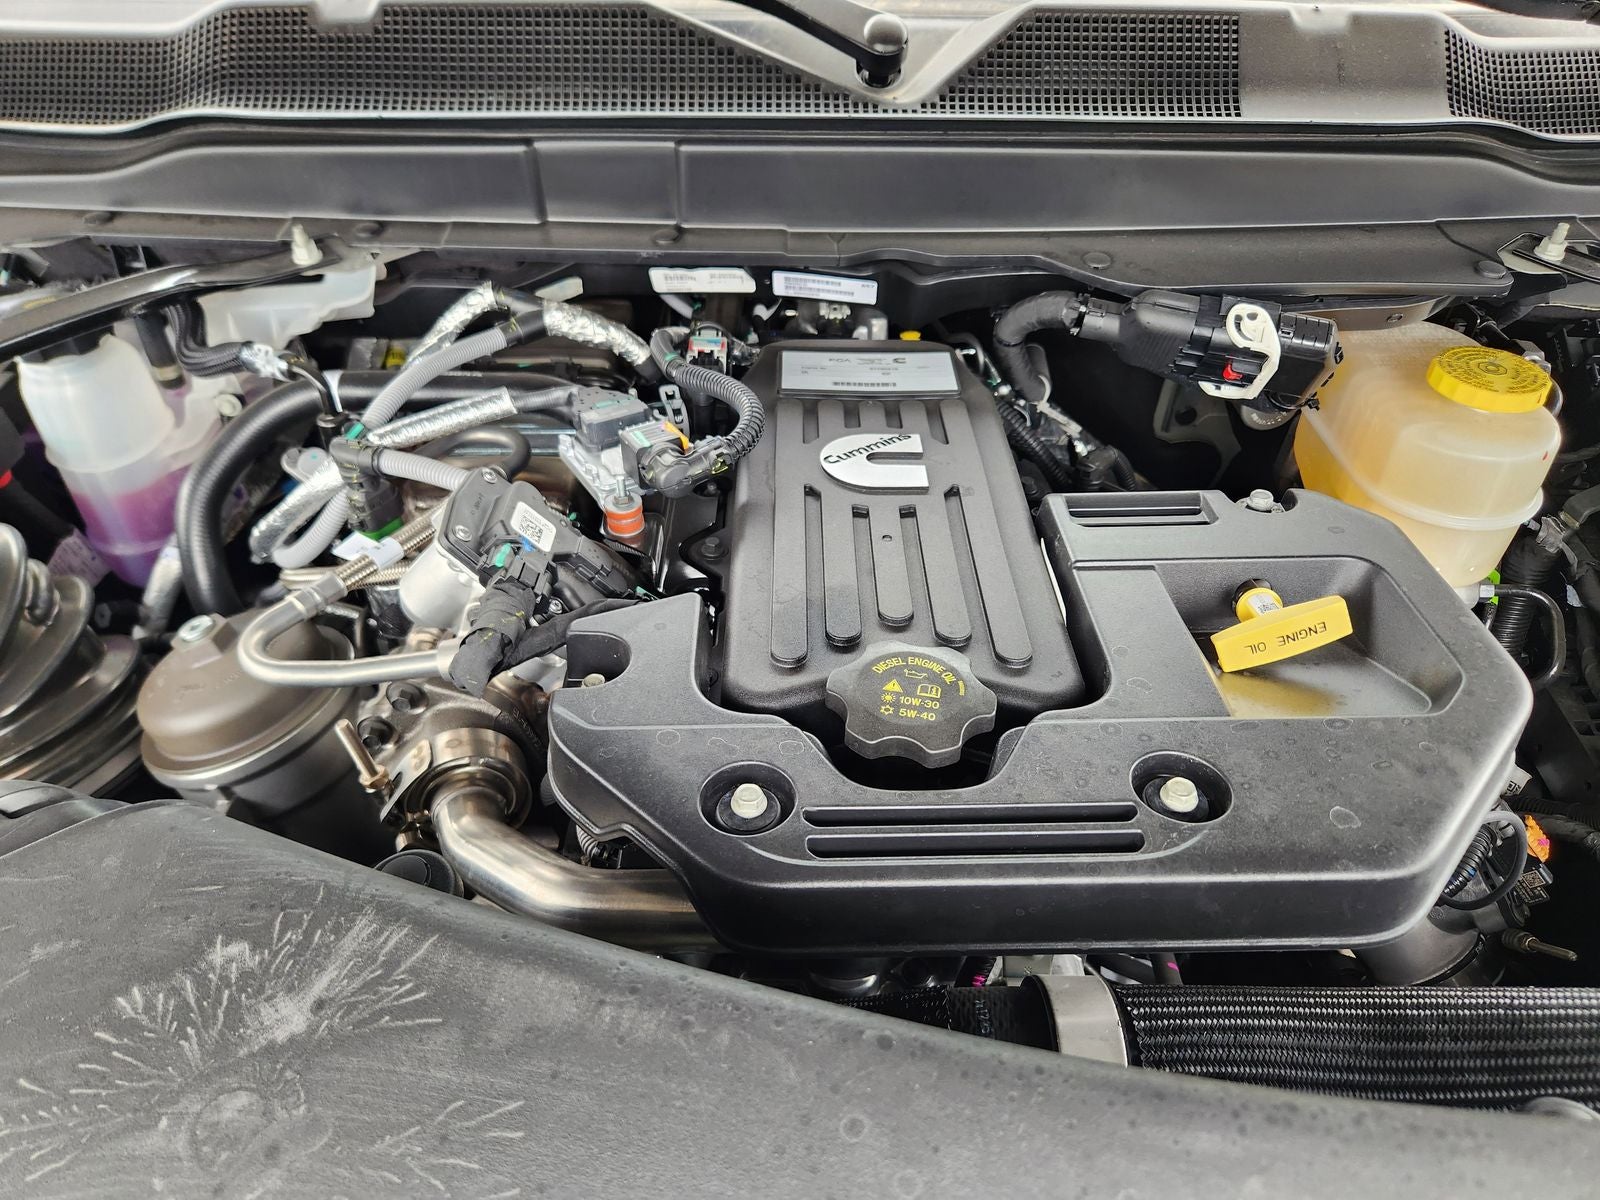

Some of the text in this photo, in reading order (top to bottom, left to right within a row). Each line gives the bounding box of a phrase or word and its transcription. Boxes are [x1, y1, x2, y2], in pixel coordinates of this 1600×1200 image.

[823, 434, 912, 464] Cummins
[1244, 621, 1327, 656] ENGINE OIL
[872, 656, 957, 685] DIESEL ENGINE OIL
[898, 708, 936, 721] 5W-40
[899, 696, 940, 709] 10W-30
